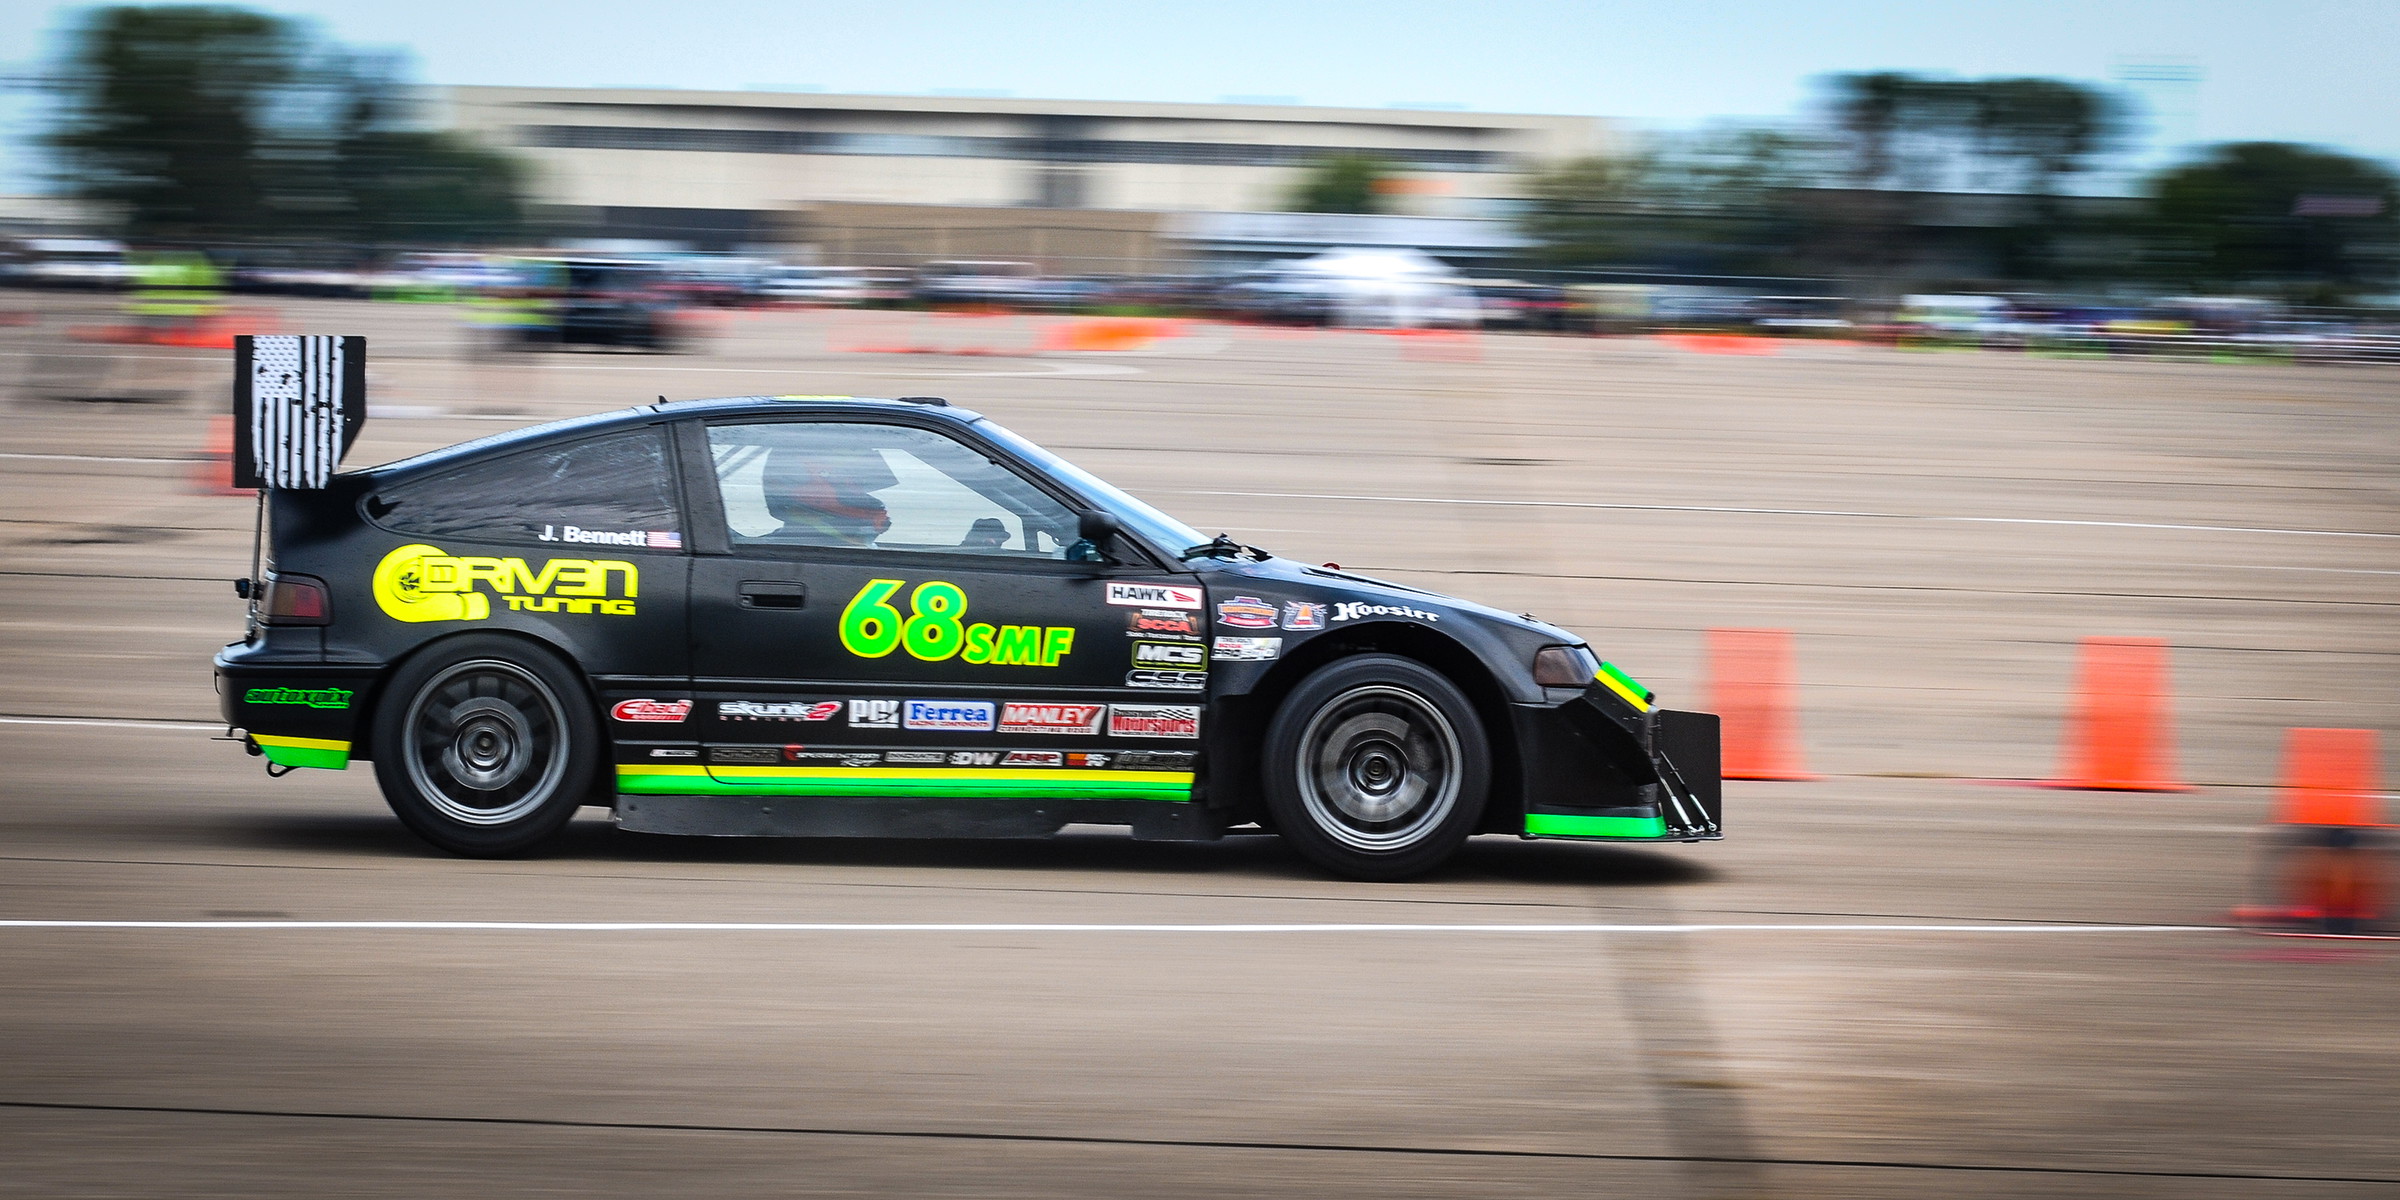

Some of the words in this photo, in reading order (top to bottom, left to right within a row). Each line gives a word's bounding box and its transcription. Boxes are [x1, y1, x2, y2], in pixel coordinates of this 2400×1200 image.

[538, 525, 559, 542] J.
[563, 526, 647, 547] Bennett
[1112, 586, 1168, 602] HAWK
[502, 595, 637, 616] TUNING
[1330, 601, 1441, 623] Hoosier
[1136, 618, 1193, 633] SCCA
[1136, 644, 1204, 664] MCS
[911, 703, 988, 721] Ferrea
[1002, 706, 1093, 724] MANLEY
[1007, 753, 1059, 762] ARP
